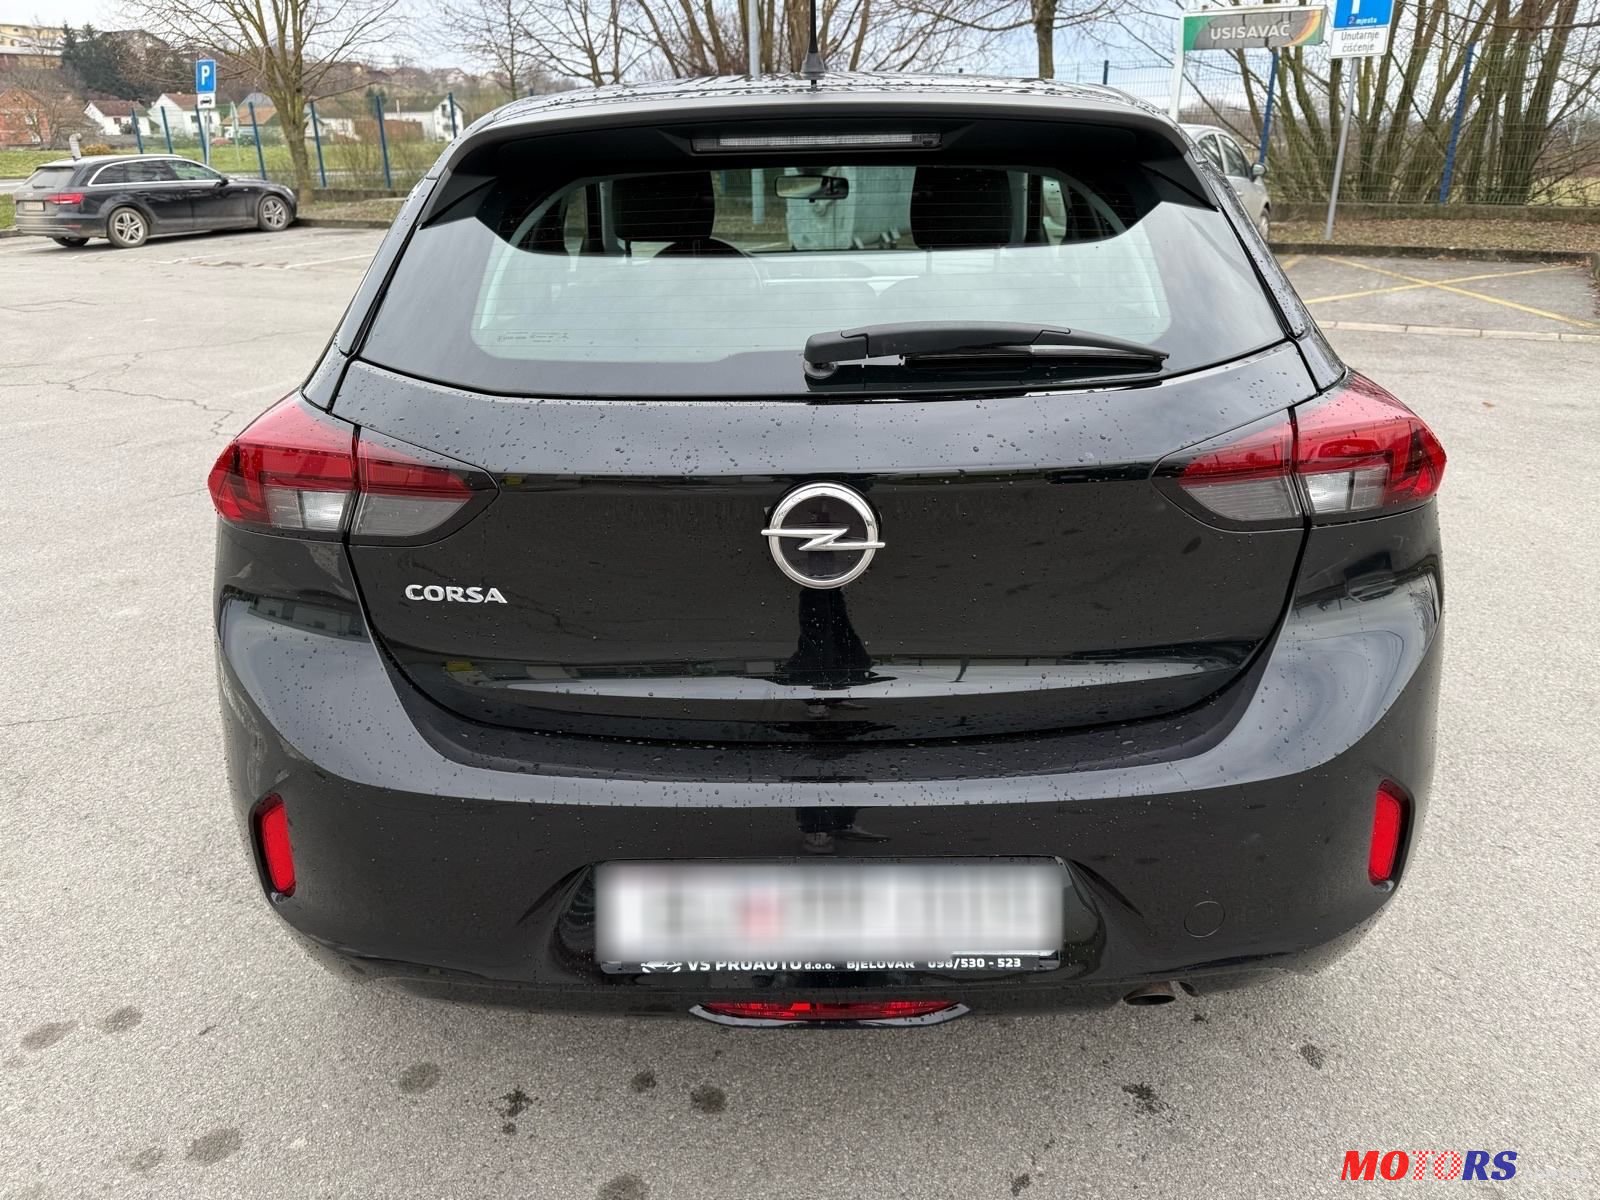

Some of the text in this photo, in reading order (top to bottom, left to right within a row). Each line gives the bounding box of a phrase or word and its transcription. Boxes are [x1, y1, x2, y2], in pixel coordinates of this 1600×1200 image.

[1210, 21, 1290, 41] USISAVAČ
[1341, 31, 1379, 41] Unutarnje
[201, 65, 210, 86] P
[405, 584, 508, 604] CORSA
[687, 960, 711, 971] VS
[715, 960, 802, 971] PROAUTO
[804, 961, 835, 970] d.o.o.
[846, 961, 915, 971] BJELOVAR
[997, 958, 1021, 968] 523
